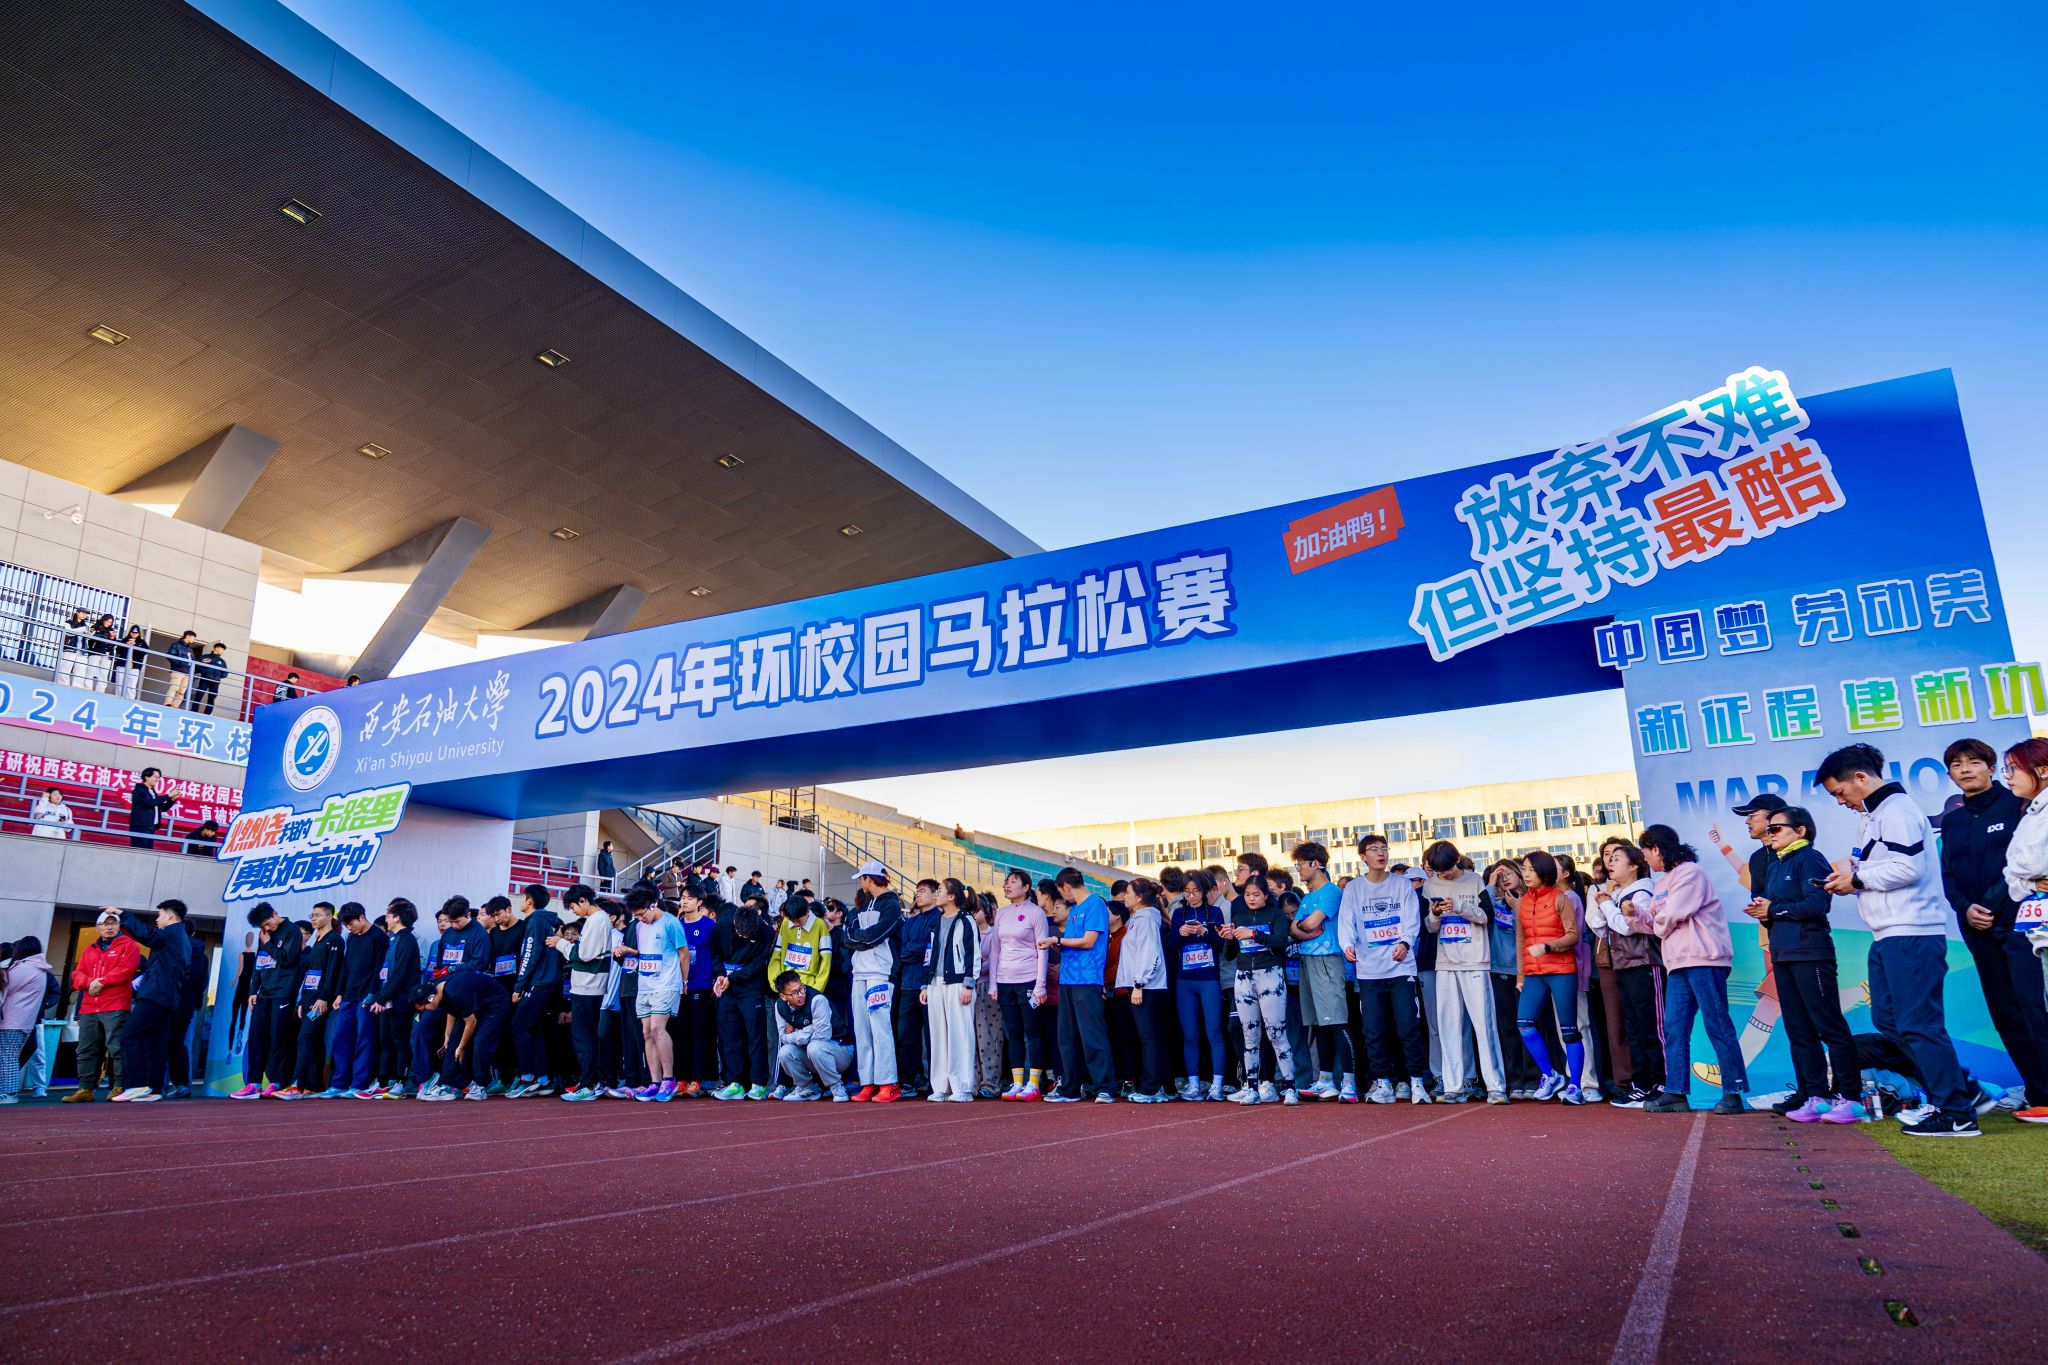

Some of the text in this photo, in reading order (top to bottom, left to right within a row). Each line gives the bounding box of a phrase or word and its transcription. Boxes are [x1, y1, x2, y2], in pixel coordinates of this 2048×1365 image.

[1463, 373, 1801, 556] 放弃不难
[1293, 507, 1388, 564] 加油鸭！
[1416, 441, 1837, 655] 但坚持最酷
[537, 552, 1232, 736] 2024年环校园马拉松赛
[1597, 570, 1990, 668] 中国梦 劳动美
[1637, 664, 2047, 755] 新征程 建新功
[355, 736, 505, 774] Xi'an Shiyou University
[225, 790, 404, 854] 燃烧我的卡路里
[230, 839, 375, 894] 勇敢向前冲
[519, 936, 534, 976] ORIGINAL
[788, 952, 806, 964] 0856
[1185, 951, 1209, 961] 0465
[1372, 926, 1399, 939] 1062
[1441, 926, 1467, 935] 1094
